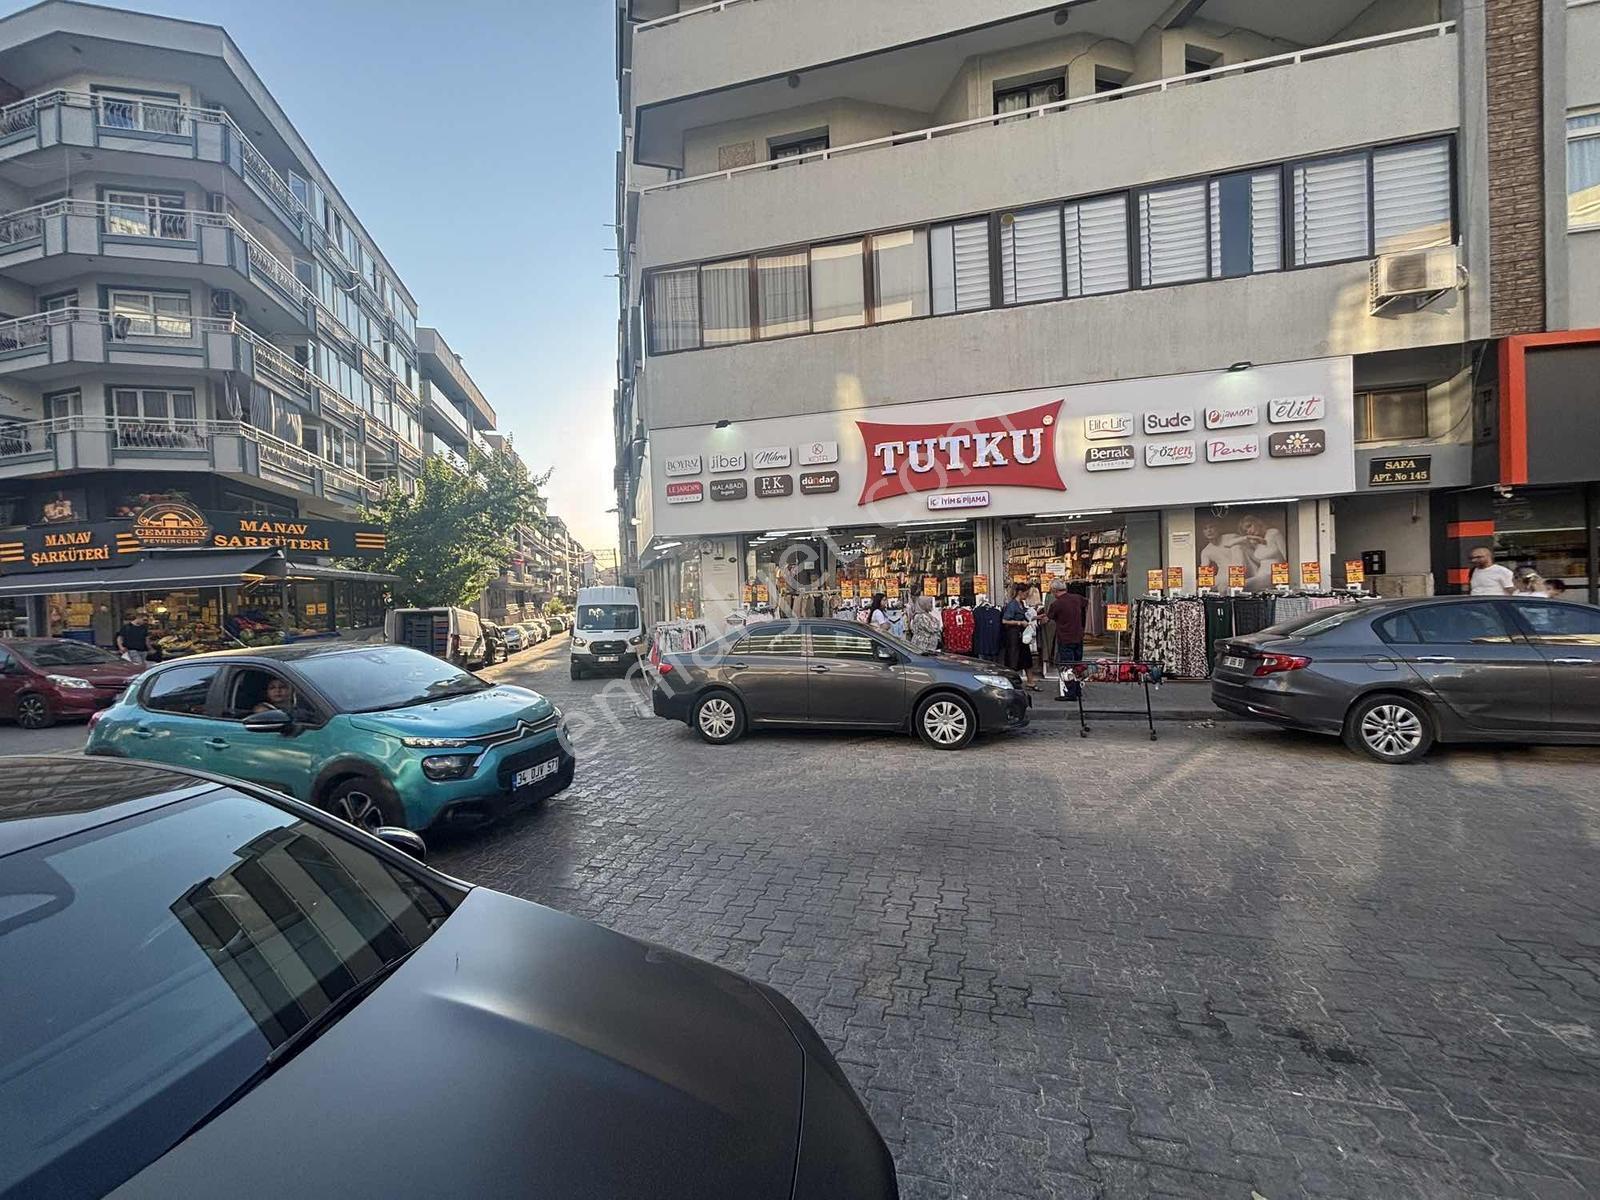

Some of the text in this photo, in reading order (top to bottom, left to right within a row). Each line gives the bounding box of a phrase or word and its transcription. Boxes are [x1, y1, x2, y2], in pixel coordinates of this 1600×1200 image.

[1275, 397, 1320, 418] elit
[1147, 412, 1191, 428] Sude
[874, 427, 1044, 476] TUTKU
[1090, 446, 1129, 459] Berrak
[1209, 441, 1257, 457] Penti
[1274, 442, 1322, 451] PAPATYA
[712, 454, 742, 469] jiber
[1384, 460, 1416, 470] SAFA
[802, 476, 836, 485] dündar
[1372, 471, 1428, 482] APT. No 145
[240, 520, 308, 535] MANAV
[44, 531, 92, 547] MANAV
[31, 544, 110, 567] ŞARKÜTERİ
[517, 771, 527, 785] 34
